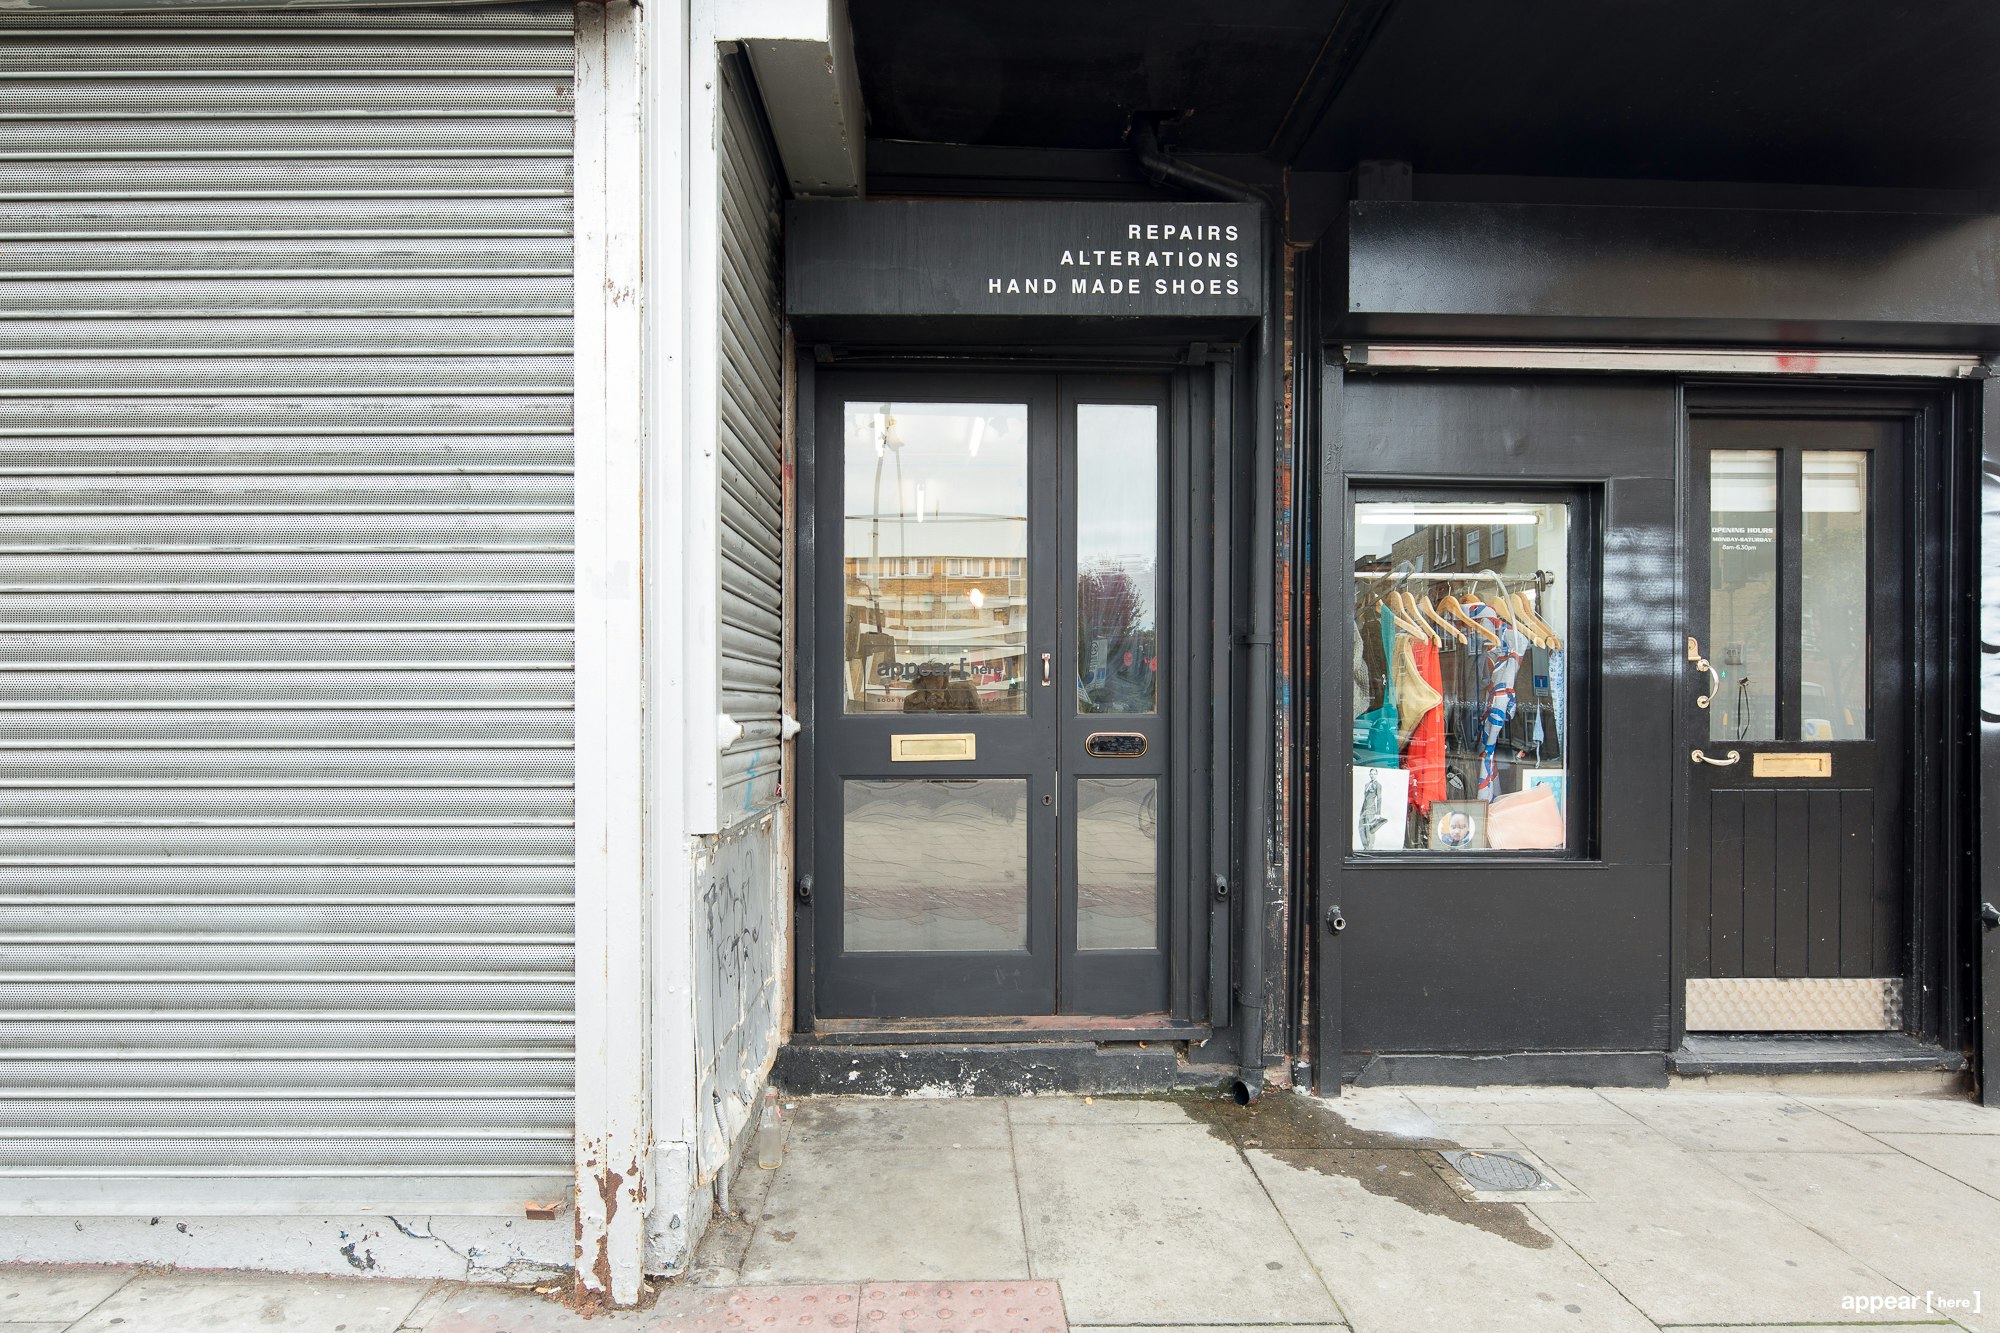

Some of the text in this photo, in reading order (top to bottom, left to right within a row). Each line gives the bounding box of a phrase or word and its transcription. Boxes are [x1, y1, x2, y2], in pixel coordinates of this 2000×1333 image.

[1128, 224, 1239, 242] REPAIRS
[1060, 249, 1239, 268] ALTERATIONS
[988, 278, 1239, 296] HAND MADE SHOES
[877, 661, 954, 680] appear
